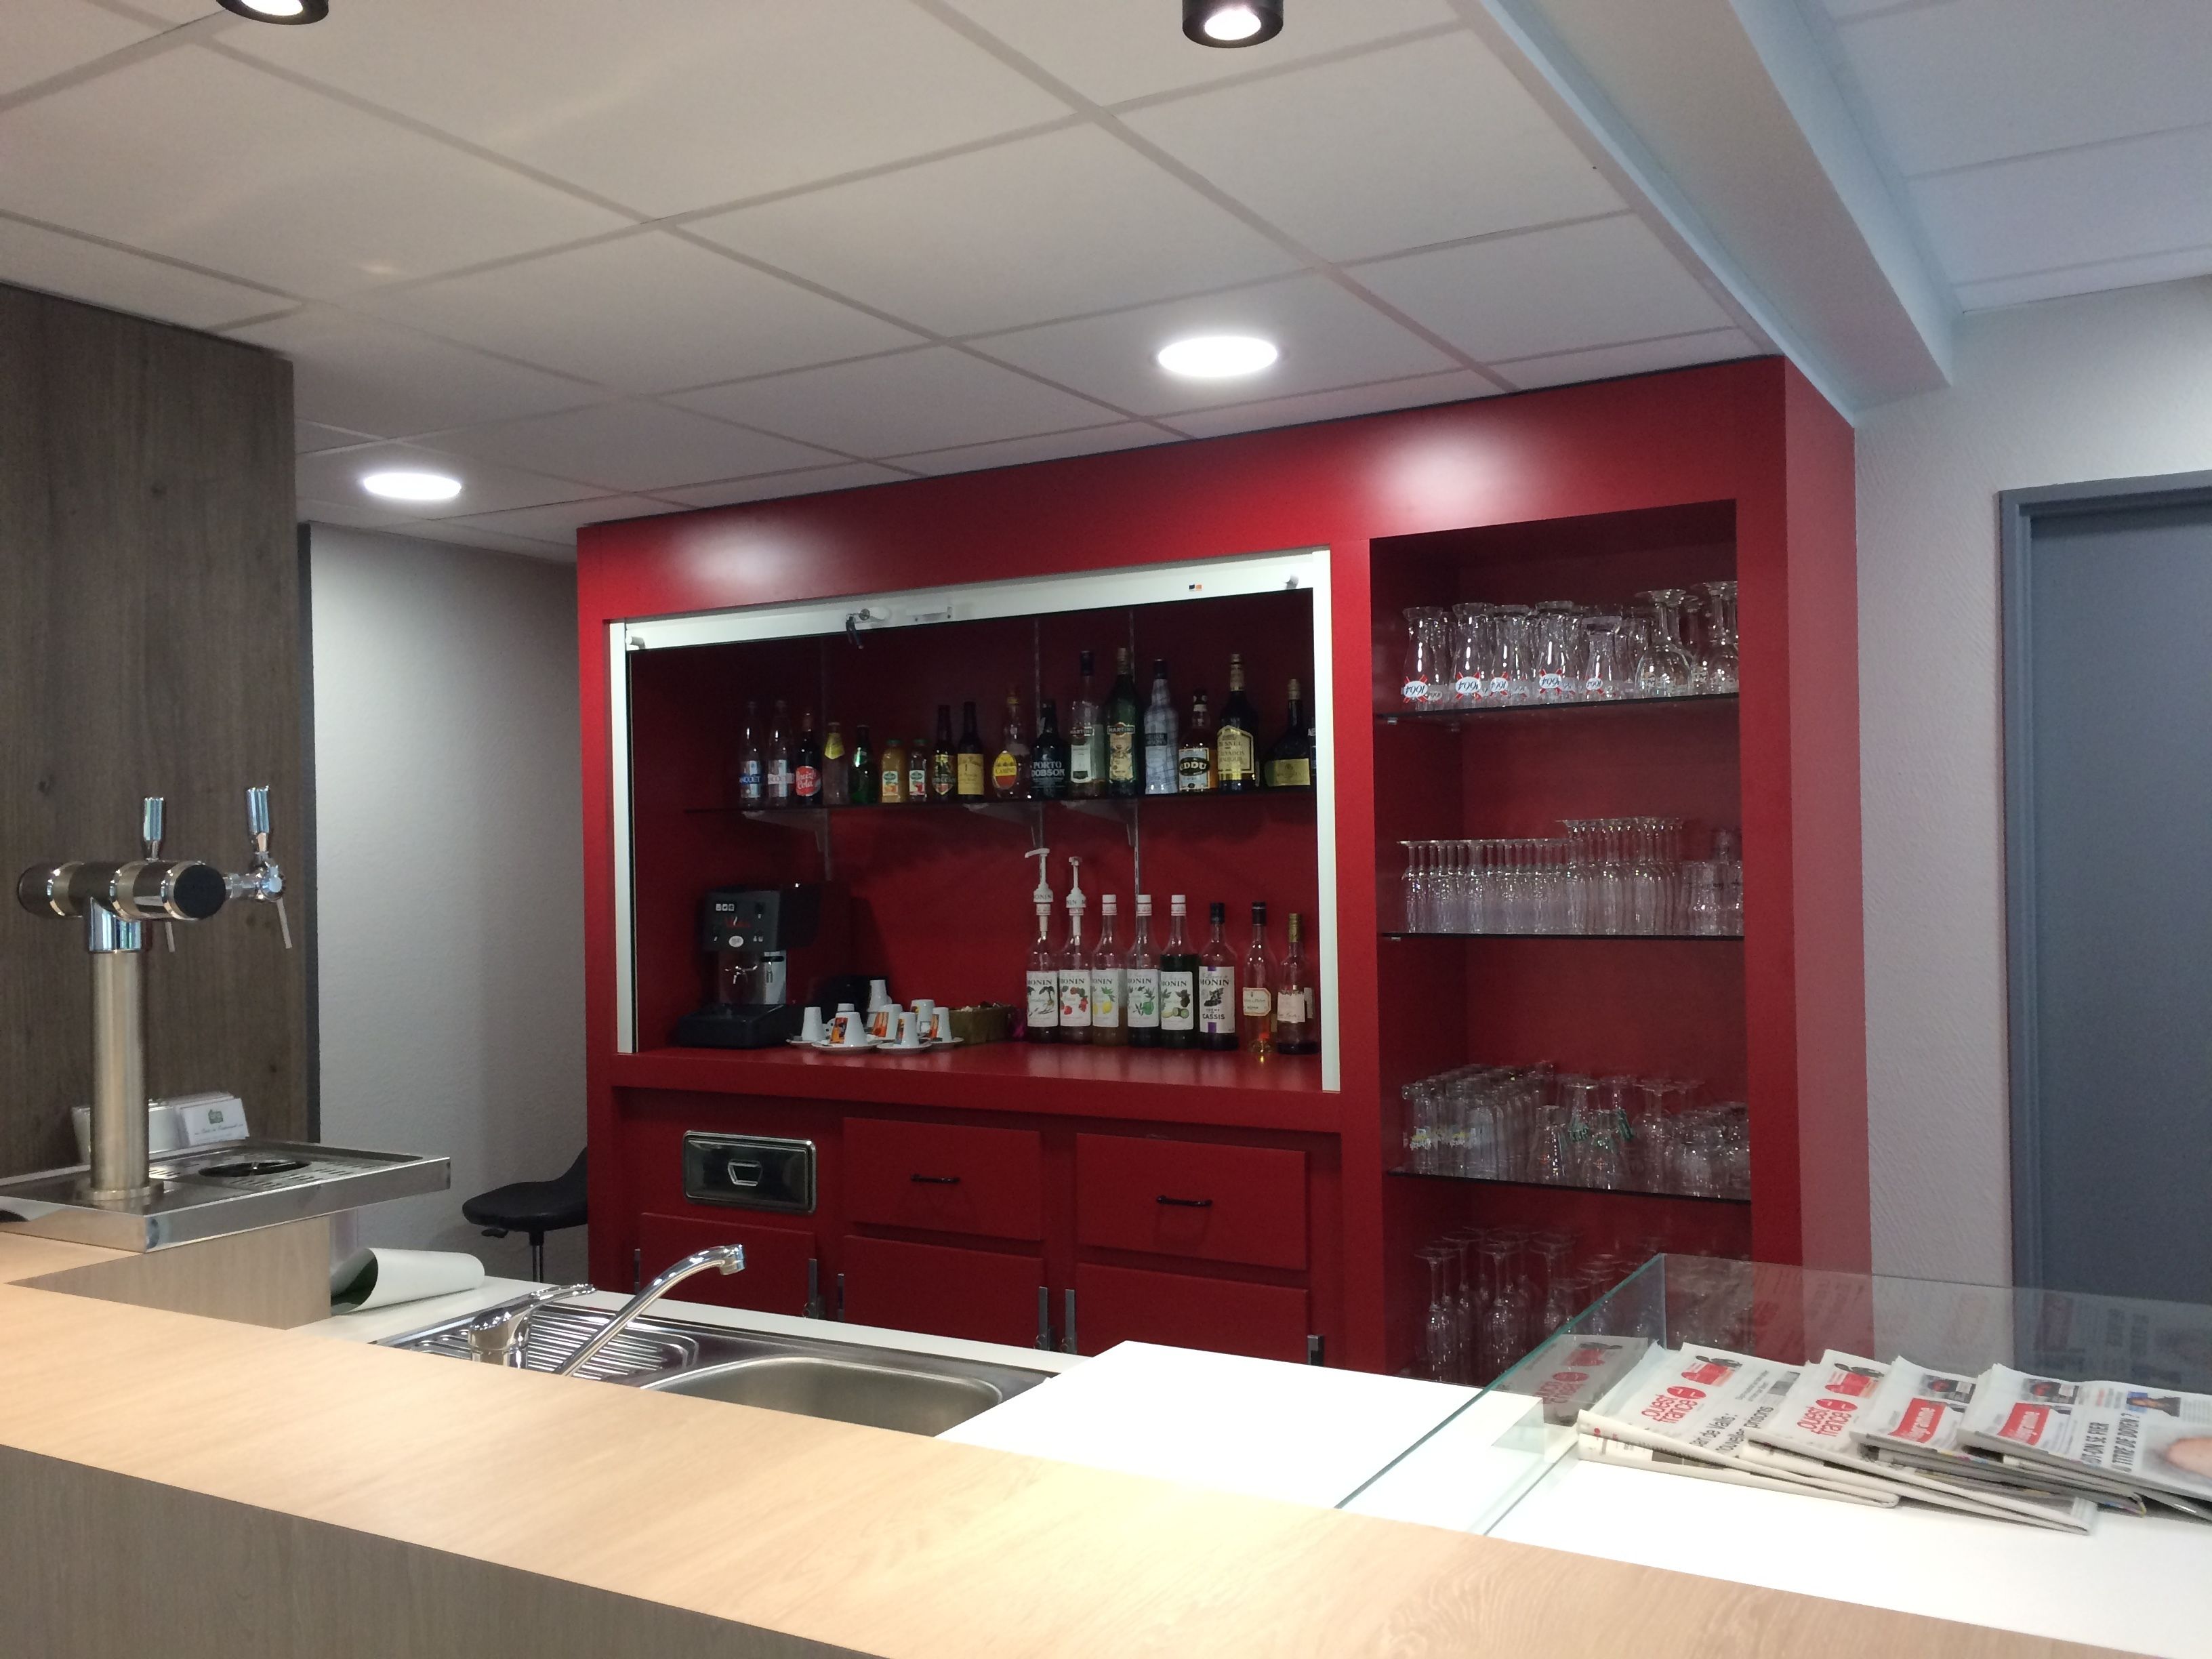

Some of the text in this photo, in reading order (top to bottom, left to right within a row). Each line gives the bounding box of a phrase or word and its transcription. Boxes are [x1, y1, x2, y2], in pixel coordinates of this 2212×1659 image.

[1458, 681, 1479, 690] 1664
[1542, 677, 1560, 686] 1664
[1406, 685, 1425, 694] 1664
[1033, 761, 1062, 769] PORTO
[1031, 769, 1065, 777] DOBSON
[1641, 1394, 1678, 1417] ouest
[1653, 1399, 1698, 1424] france
[1797, 1406, 1830, 1429] ouest
[1811, 1412, 1852, 1437] france
